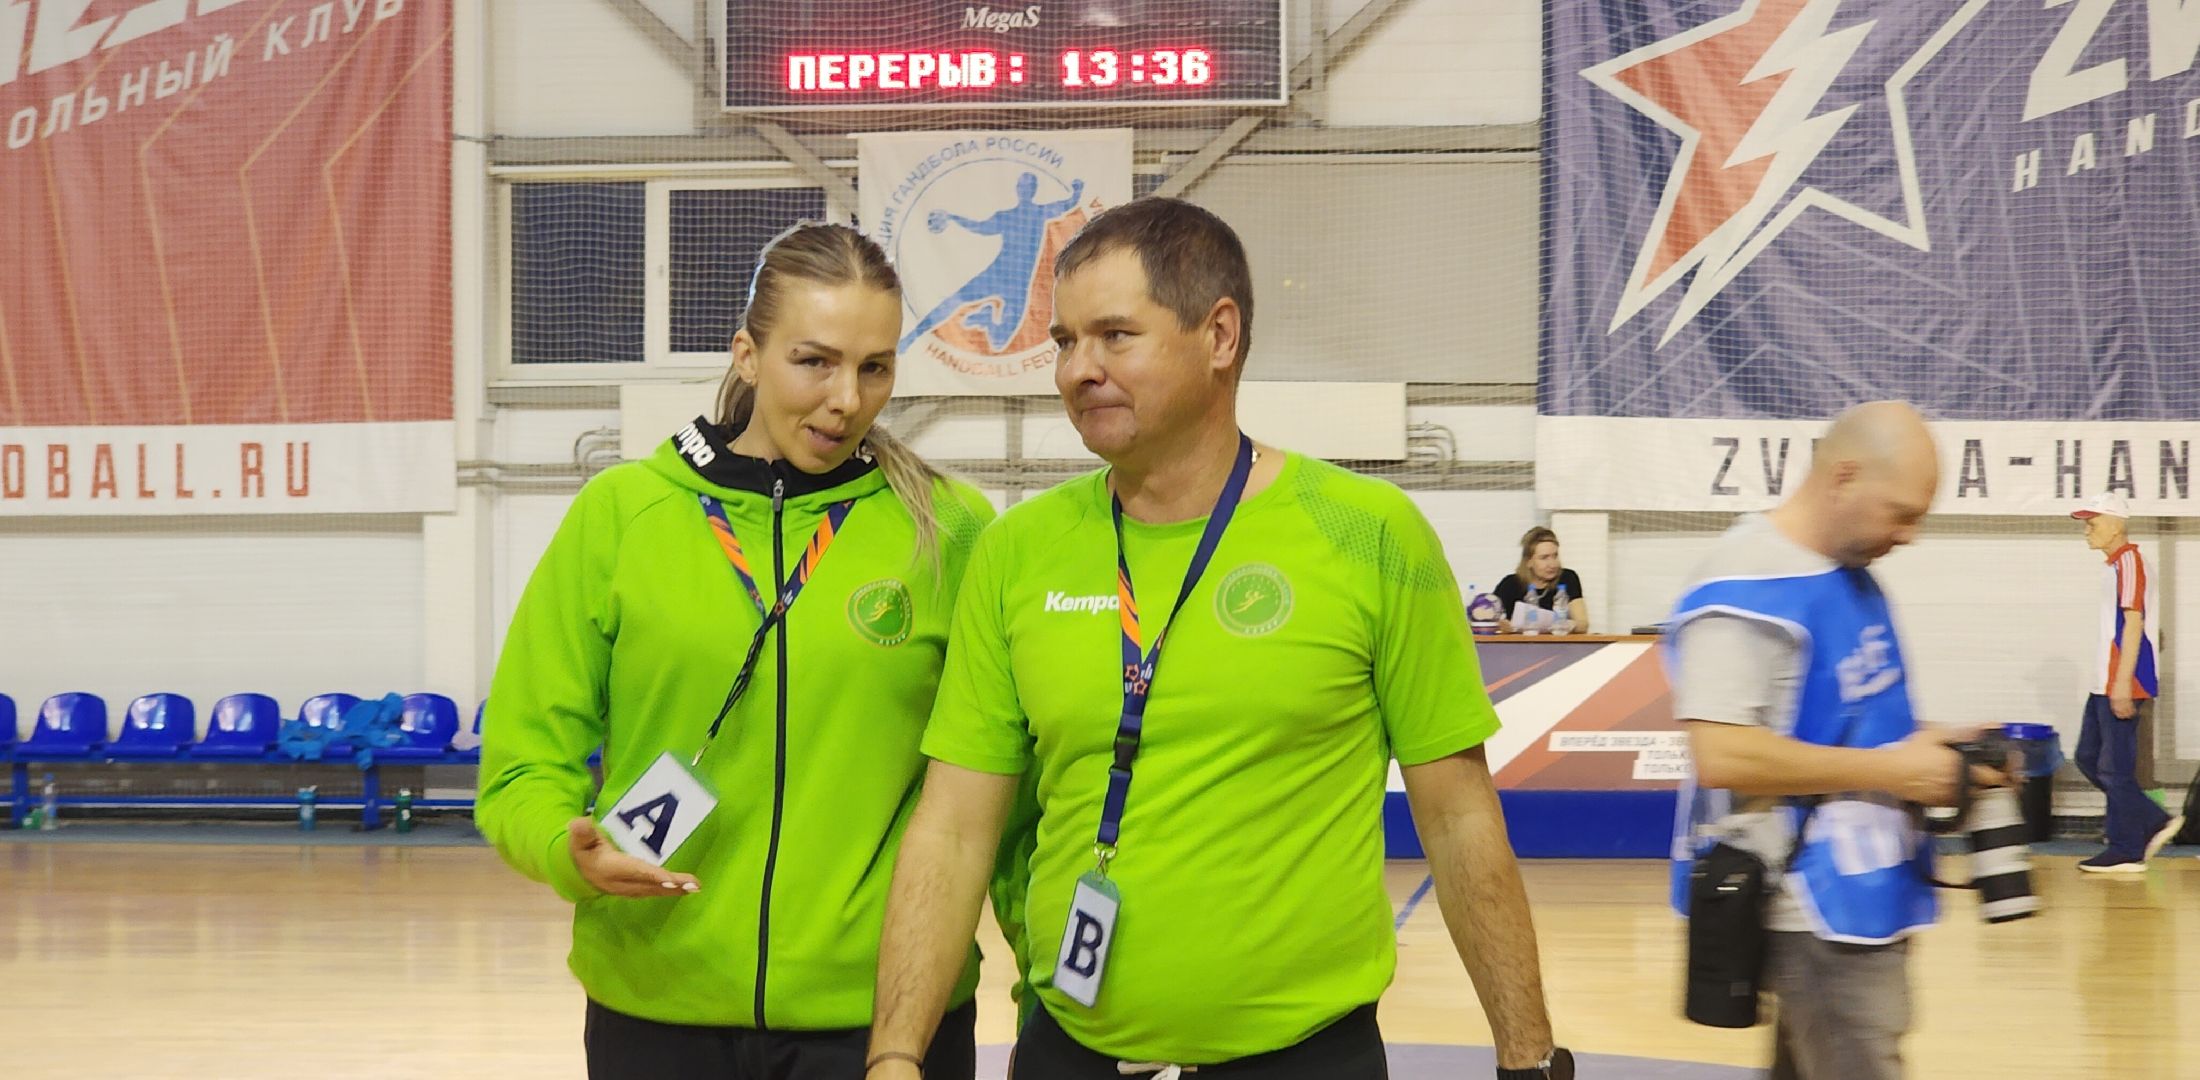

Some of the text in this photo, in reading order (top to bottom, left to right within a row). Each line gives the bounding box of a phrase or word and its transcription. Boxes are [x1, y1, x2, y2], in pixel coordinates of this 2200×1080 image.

[962, 5, 1041, 33] MegaS
[787, 50, 1211, 91] ПЕРЕРЫВ: 13:36
[892, 139, 980, 205] ГАНДБОЛА
[985, 136, 1065, 169] РОССИИ
[616, 792, 679, 857] A
[1063, 908, 1104, 979] B
